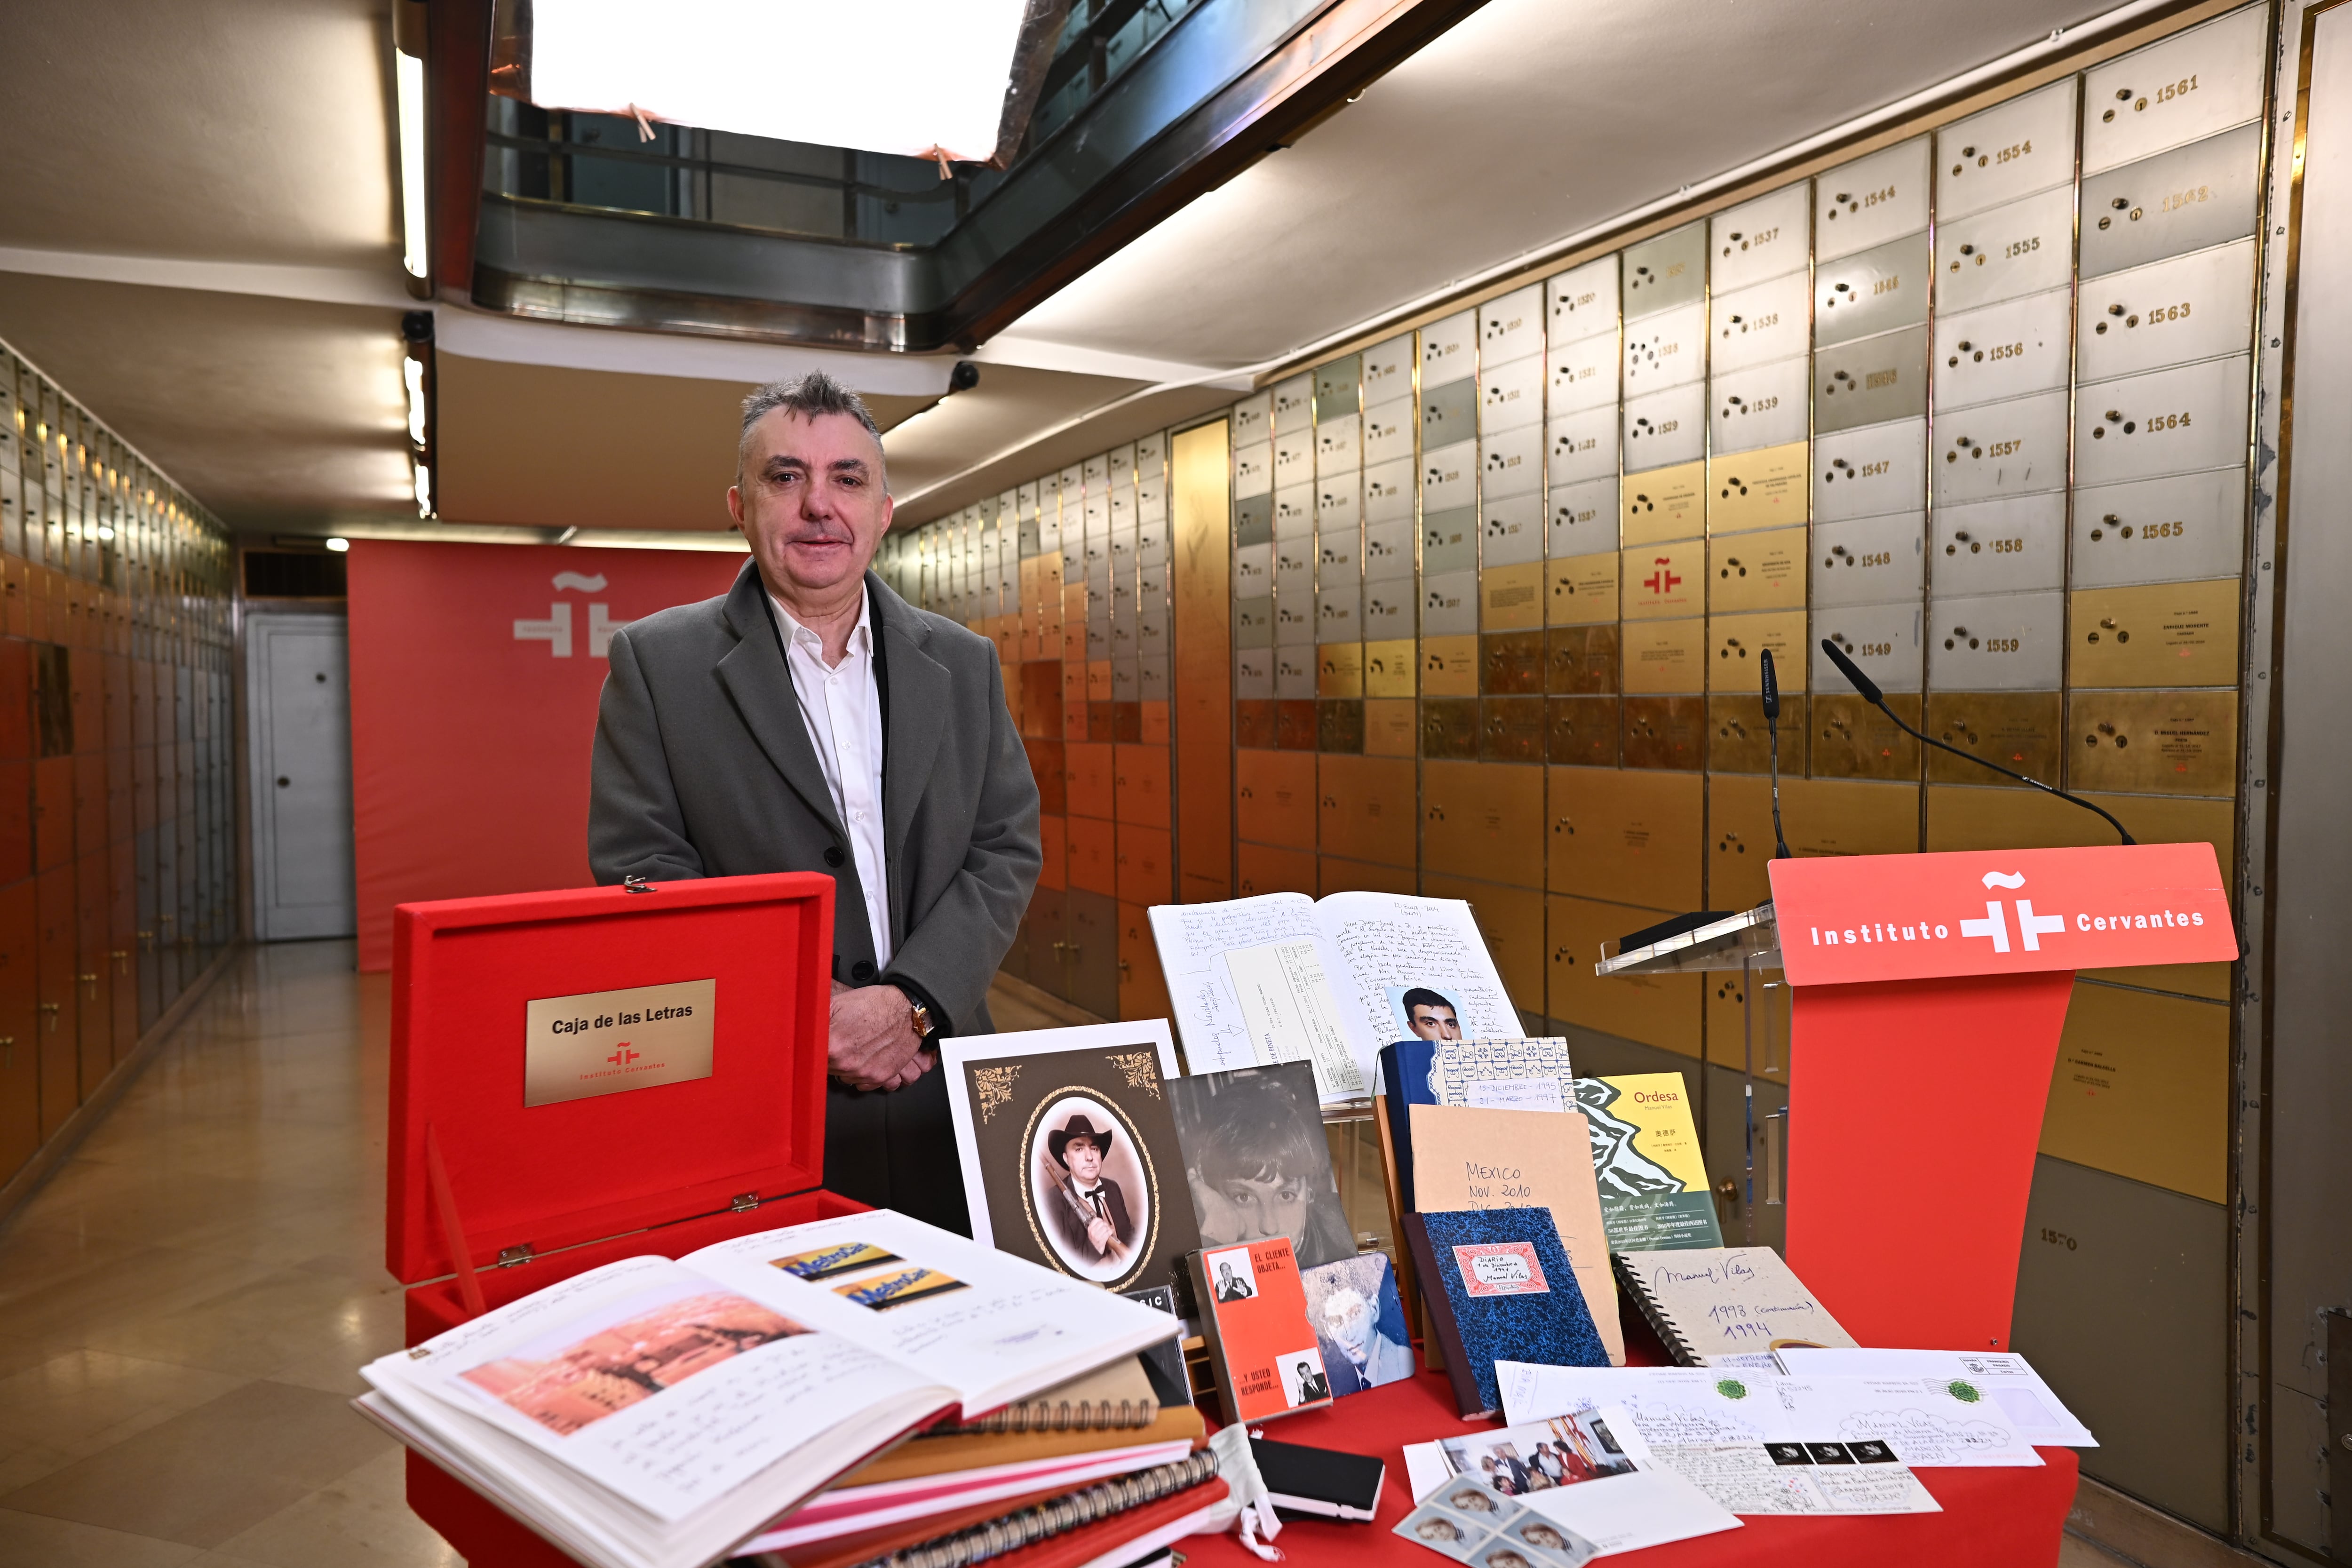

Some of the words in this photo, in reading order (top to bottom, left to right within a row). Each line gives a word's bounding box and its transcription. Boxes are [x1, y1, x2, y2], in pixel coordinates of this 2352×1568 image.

[2156, 75, 2199, 104] 1561
[1996, 141, 2033, 164] 1554
[1864, 186, 1897, 207] 1544
[2162, 186, 2209, 212] 1562
[1753, 227, 1779, 247] 1537
[2006, 237, 2041, 259] 1555
[1753, 313, 1778, 332] 1538
[2147, 302, 2192, 325] 1563
[1989, 343, 2024, 361] 1556
[1752, 397, 1778, 414] 1539
[2147, 412, 2192, 433] 1564
[1989, 440, 2021, 458] 1557
[1861, 461, 1890, 478] 1547
[2142, 522, 2183, 540] 1565
[1989, 539, 2023, 554] 558
[1861, 551, 1891, 566] 1548
[1861, 642, 1891, 656] 1549
[1986, 638, 2019, 653] 1559
[2030, 779, 2053, 790] SENNHEISER
[1810, 920, 1949, 946] Instituto
[2076, 909, 2205, 932] Cervantes
[552, 1018, 588, 1035] Caja
[595, 1015, 613, 1028] de
[619, 1012, 641, 1025] las
[646, 1006, 692, 1021] Letras
[1264, 1033, 1275, 1051] PINETA
[580, 1068, 621, 1081] Instituto
[625, 1062, 665, 1073] Cervantes
[2075, 1059, 2093, 1067] CARMEN
[2094, 1064, 2115, 1072] BALCELLS
[1536, 1082, 1556, 1090] 1995
[1535, 1093, 1557, 1103] 1997
[1634, 1091, 1678, 1103] Ordesa
[1466, 1162, 1520, 1181] MEXICO
[1470, 1186, 1494, 1197] NOV.
[1501, 1185, 1530, 1198] 2010
[1255, 1253, 1262, 1263] EL
[1265, 1248, 1290, 1260] CLIENTE
[1257, 1261, 1286, 1274] OBJETA...
[1483, 1273, 1507, 1282] Manuel
[1511, 1269, 1527, 1279] Vilas
[1654, 1266, 1719, 1296] Manuel
[1719, 1254, 1755, 1282] Vilas
[1708, 1305, 1746, 1324] 1993
[1724, 1321, 1772, 1339] 1994
[1251, 1368, 1270, 1381] USTED
[1241, 1380, 1279, 1396] RESPONDE...
[1632, 1412, 1670, 1423] Manuel
[1674, 1412, 1705, 1422] Vilas
[1857, 1419, 1908, 1432] MANUEL
